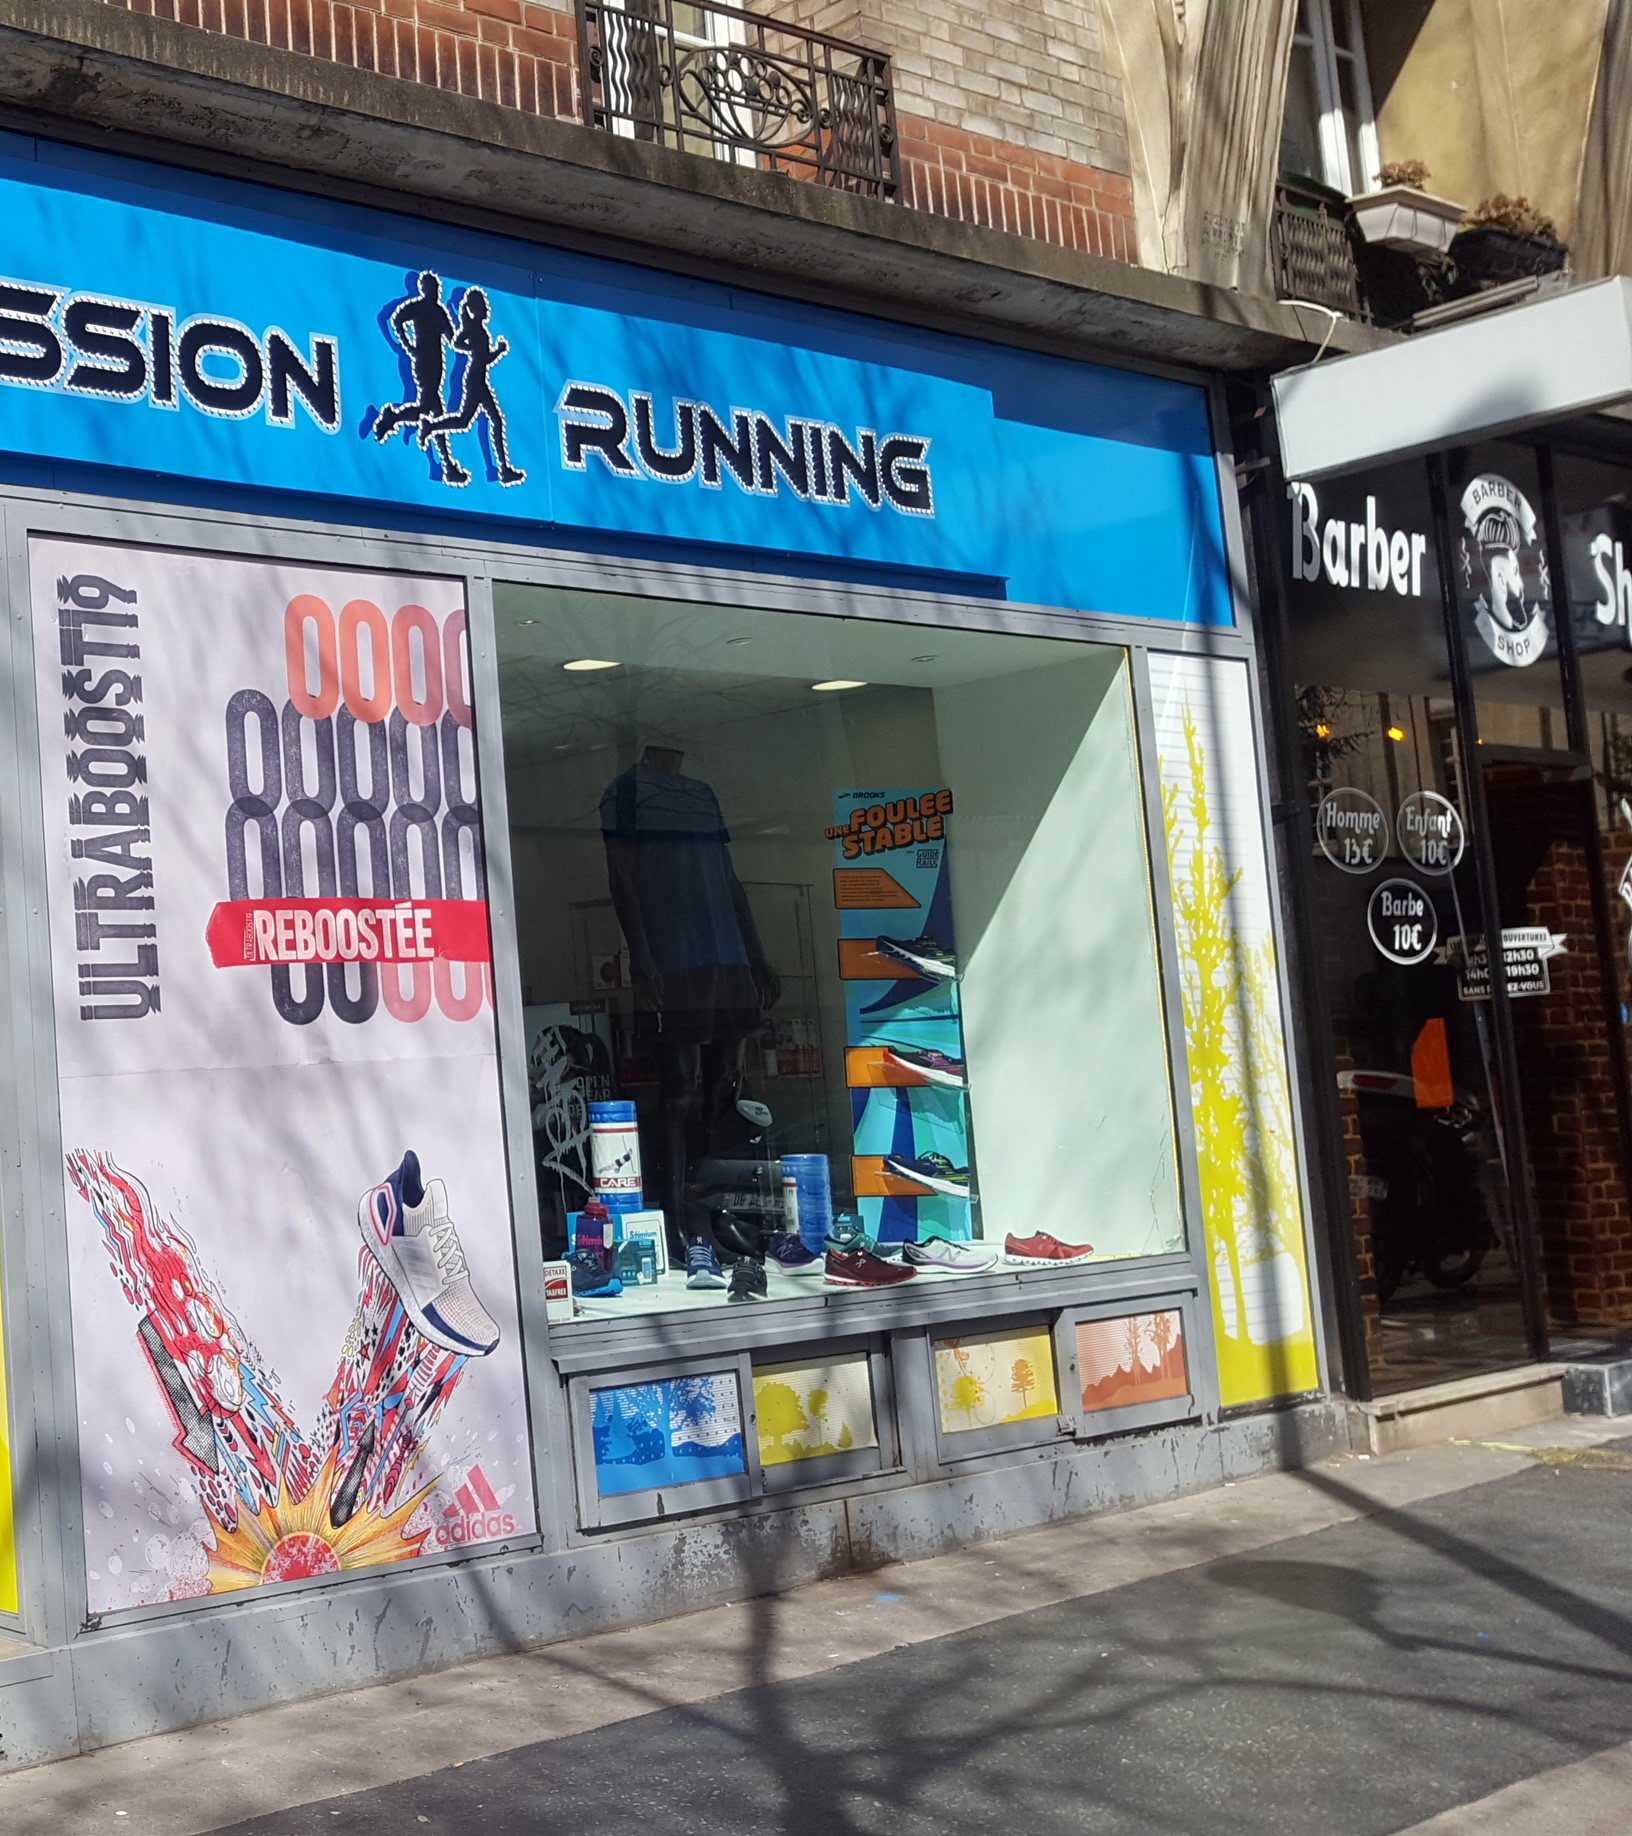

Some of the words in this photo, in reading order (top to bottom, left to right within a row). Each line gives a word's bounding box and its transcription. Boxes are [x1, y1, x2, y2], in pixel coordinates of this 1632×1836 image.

[557, 381, 934, 517] RUNNING
[1471, 481, 1522, 511] BARBER
[1287, 481, 1426, 597] Barber
[1497, 637, 1531, 656] SHOP
[852, 791, 886, 799] BROOKS
[850, 789, 954, 833] FOULEE
[1325, 801, 1381, 834] Homme
[1405, 805, 1453, 839] Enfant
[842, 815, 945, 861] STABLE
[1420, 840, 1448, 866] 10€
[1381, 890, 1424, 917] Barbe
[253, 901, 435, 961] REBOOSTÉE
[1393, 923, 1423, 951] 10€
[600, 1177, 637, 1188] CARE
[545, 1287, 567, 1297] TAXFREE
[434, 1512, 515, 1545] adidas
